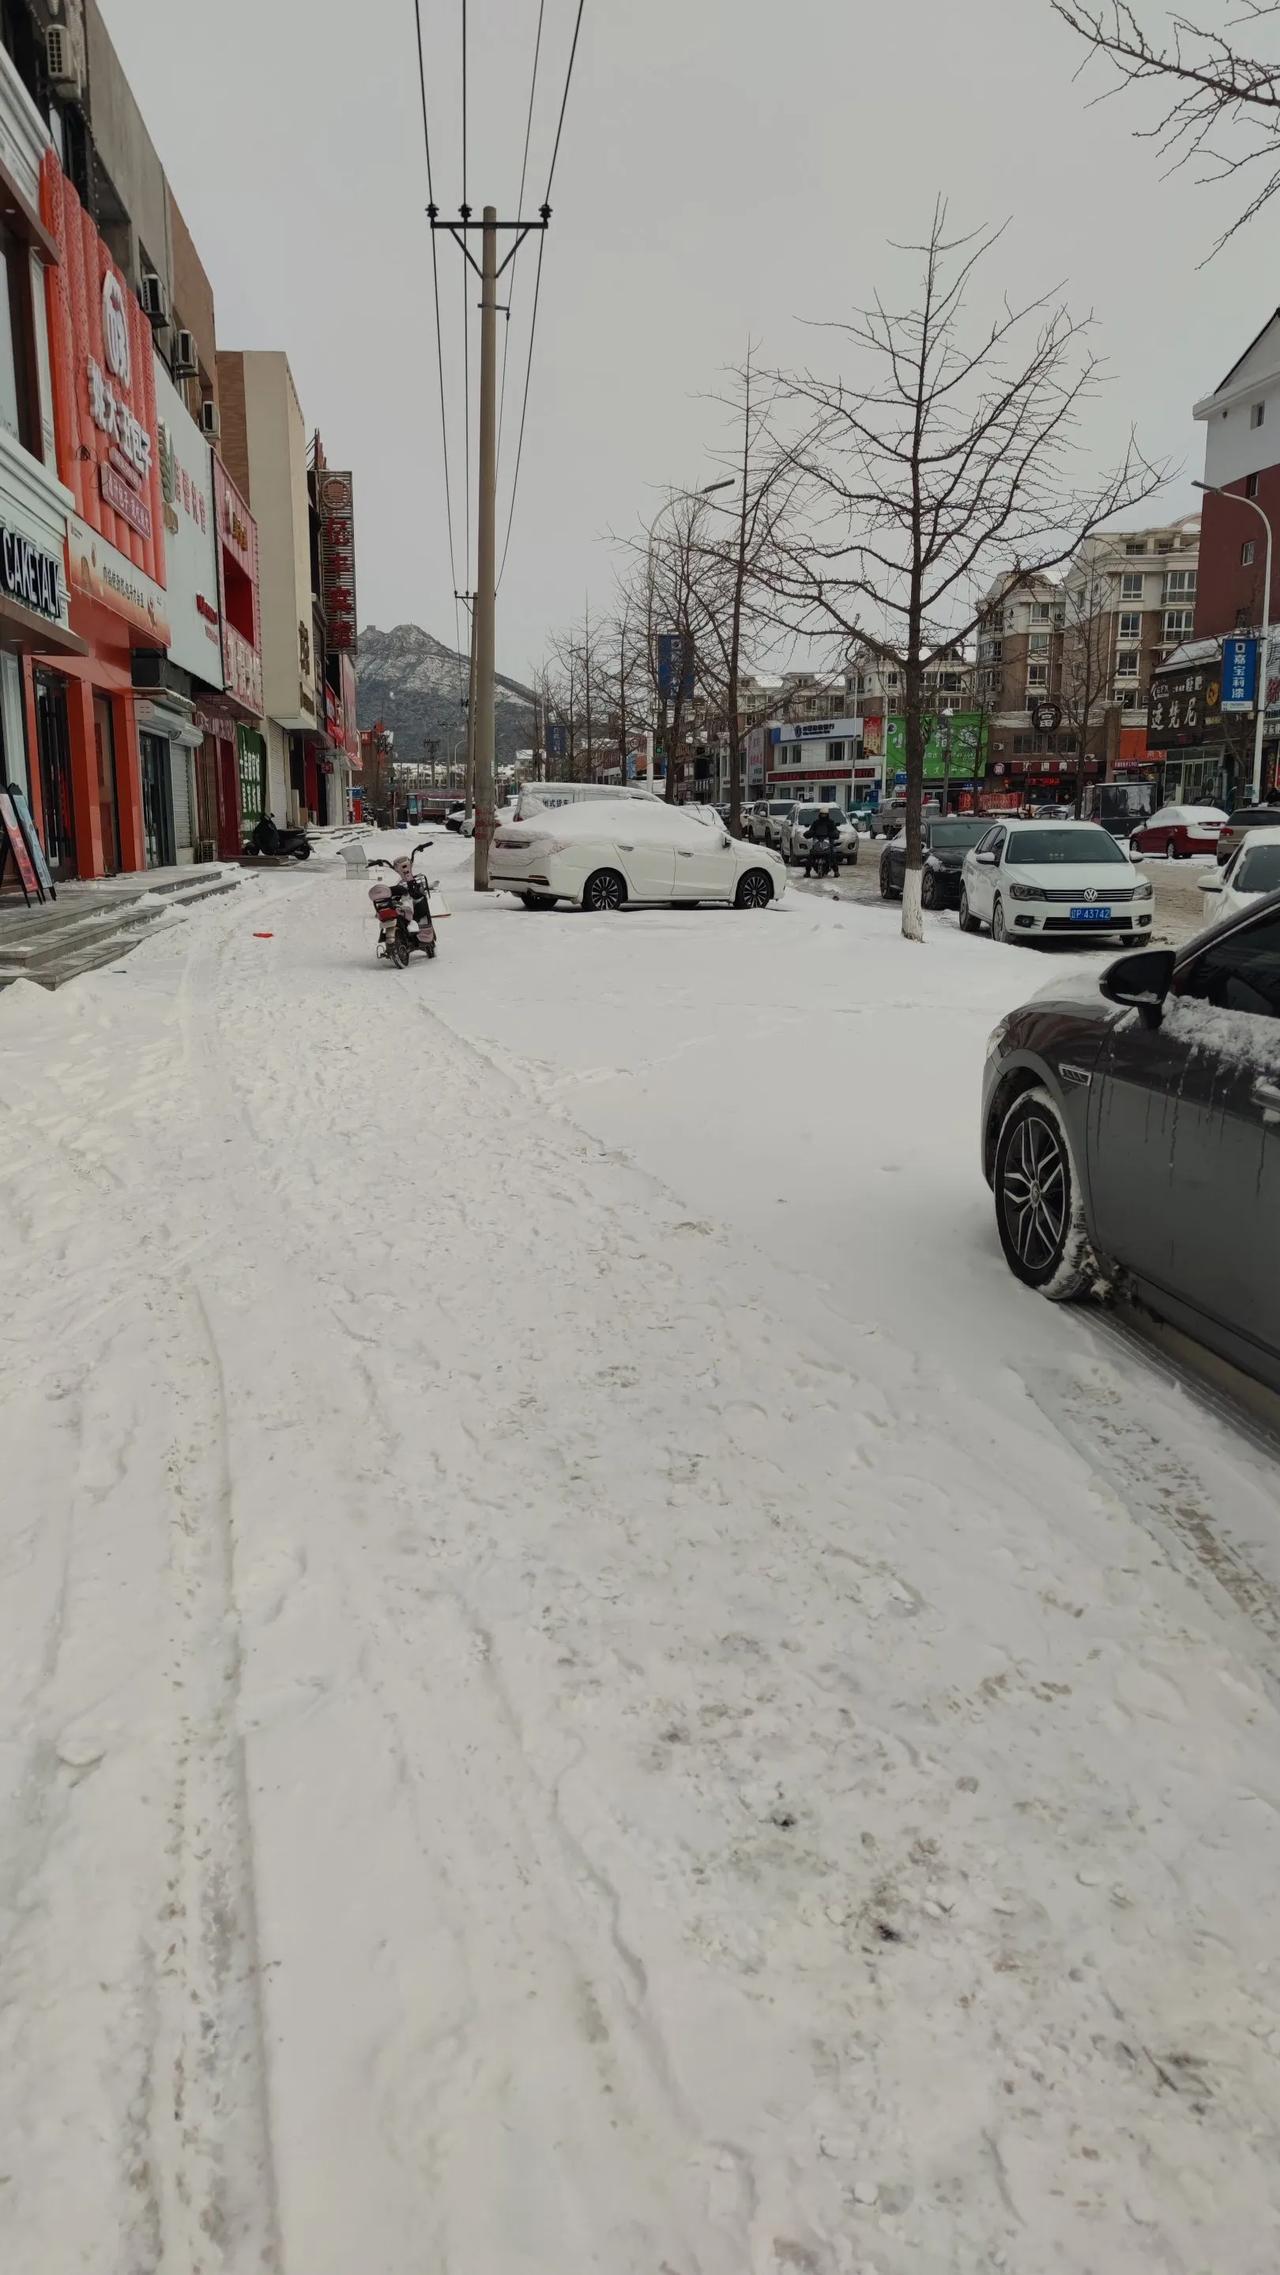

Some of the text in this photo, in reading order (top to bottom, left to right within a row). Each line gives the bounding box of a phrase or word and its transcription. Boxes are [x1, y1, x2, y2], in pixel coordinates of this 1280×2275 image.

[2, 527, 62, 618] CAKETALK
[1231, 654, 1246, 699] 嘉宝莉漆
